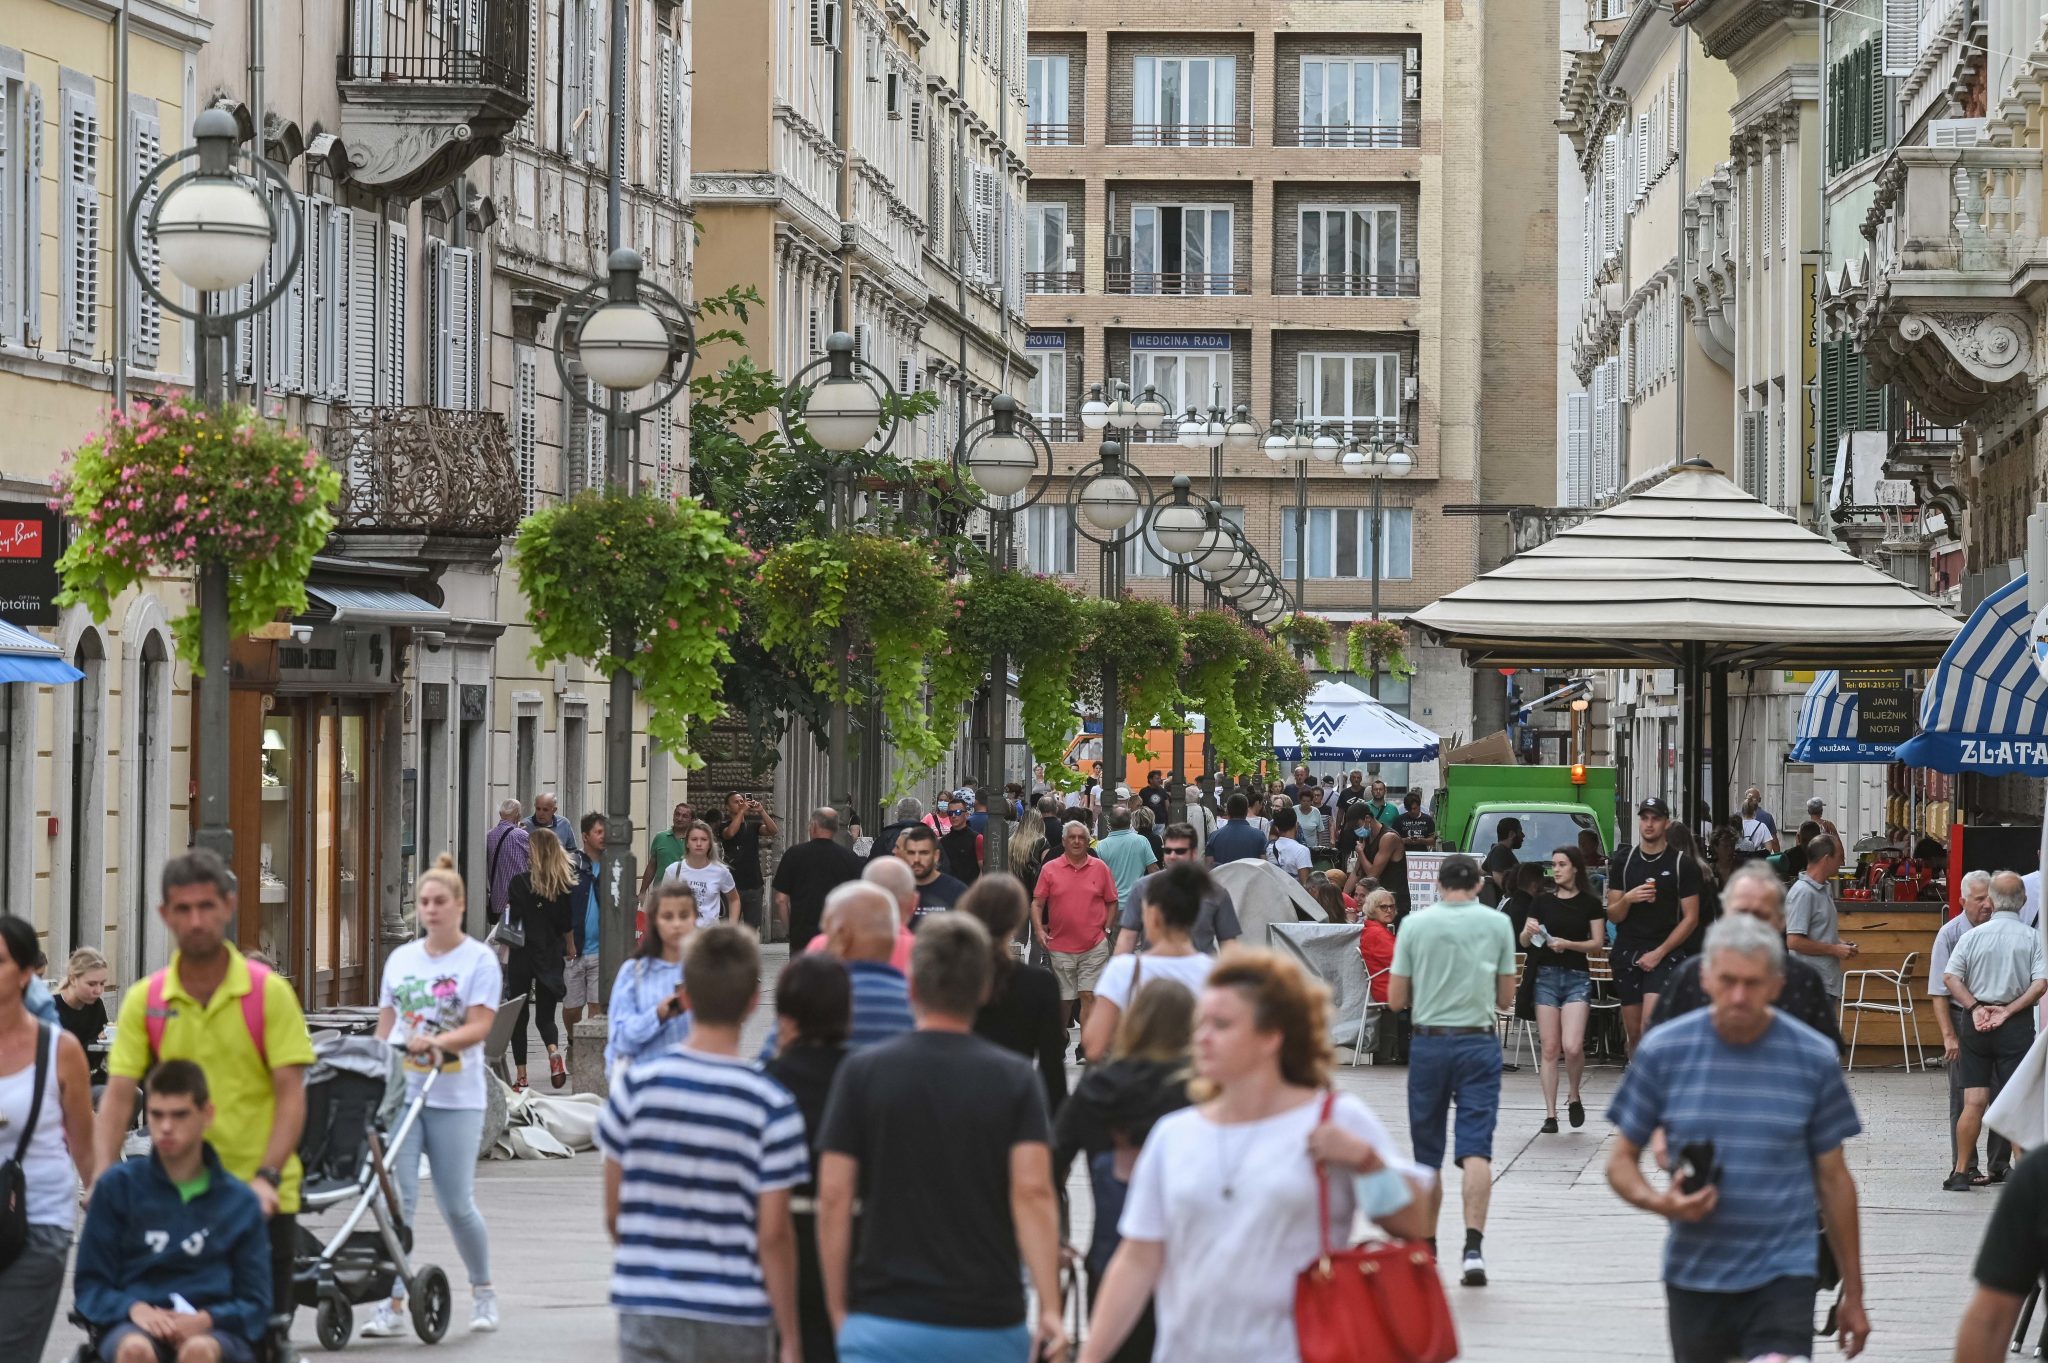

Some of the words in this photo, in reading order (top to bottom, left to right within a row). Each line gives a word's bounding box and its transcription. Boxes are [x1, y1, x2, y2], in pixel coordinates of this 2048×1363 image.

[1025, 335, 1042, 345] PRO
[1043, 335, 1063, 345] VITA
[1137, 335, 1189, 346] MEDICINA
[1194, 335, 1224, 346] RADA
[0, 600, 40, 611] ptotim
[1872, 698, 1898, 706] JAVNI
[1863, 709, 1907, 720] BILJEŽNIK
[1819, 744, 1850, 753] KNJIŽARA
[1960, 740, 2048, 764] ZLATA
